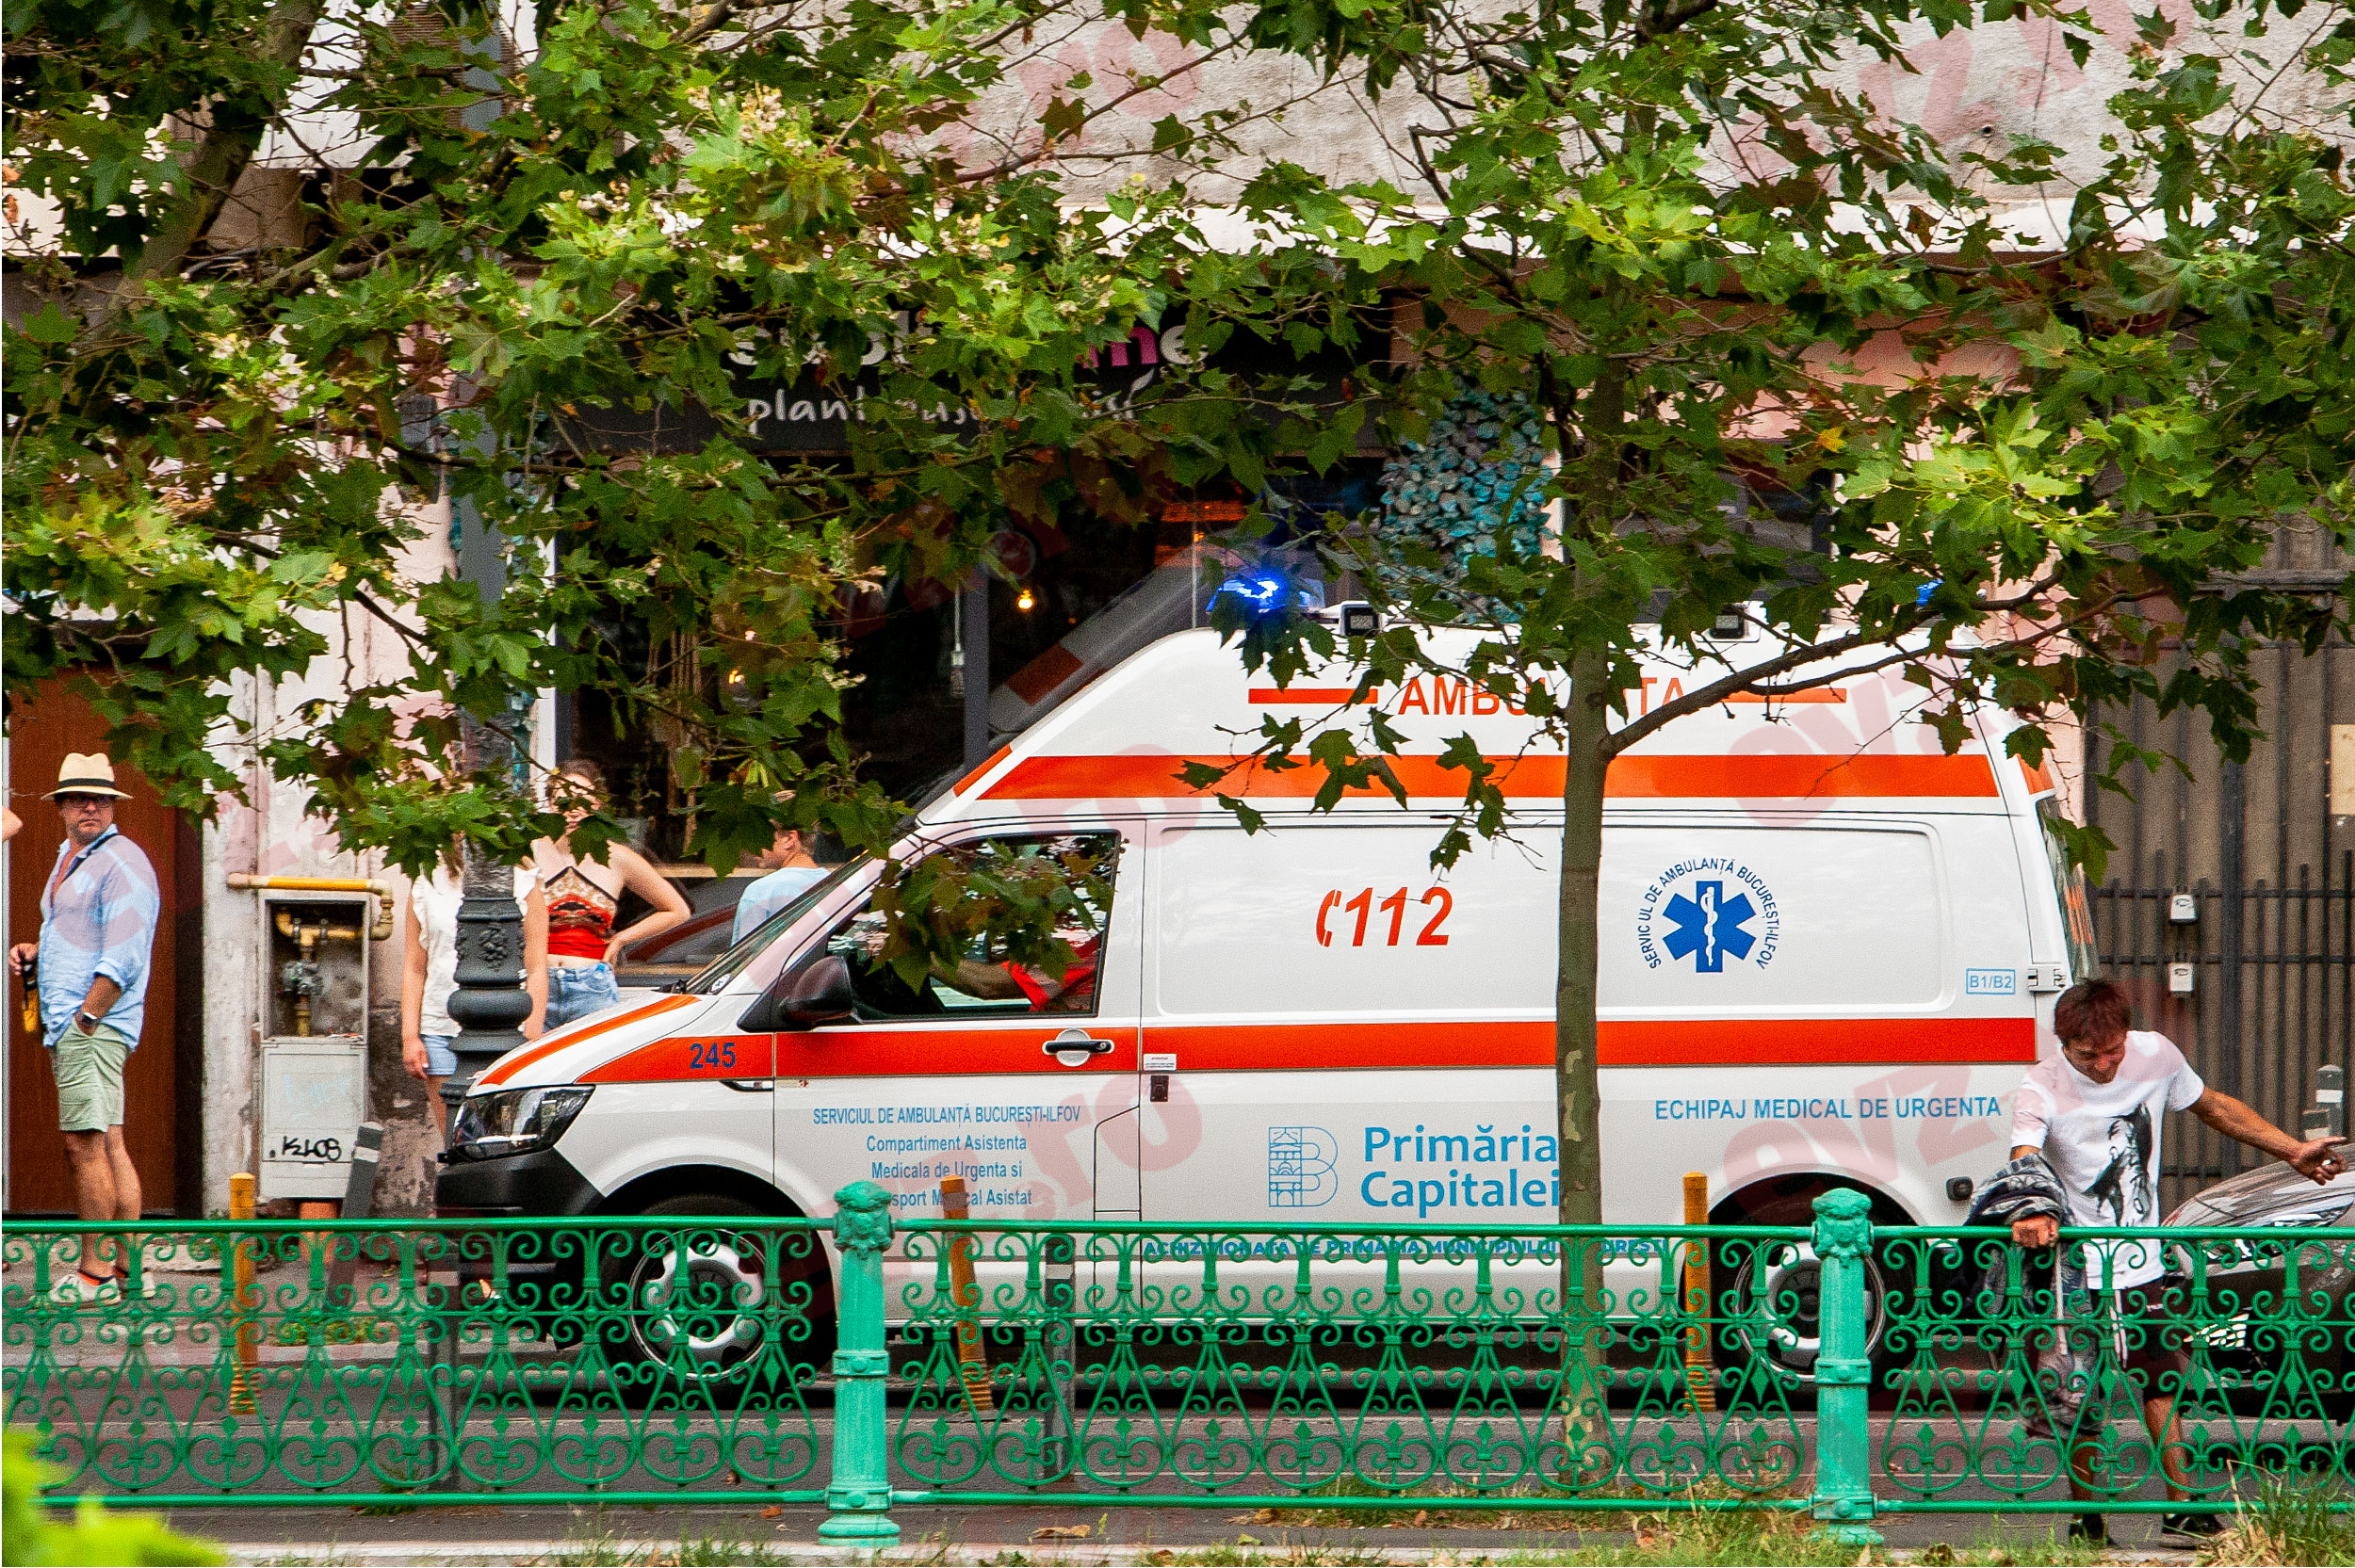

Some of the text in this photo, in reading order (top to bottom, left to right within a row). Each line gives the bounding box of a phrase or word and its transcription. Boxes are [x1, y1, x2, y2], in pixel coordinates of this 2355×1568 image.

[1398, 677, 1685, 716] AMBUTA
[1644, 884, 1663, 904] DE
[1345, 887, 1453, 946] 112
[1970, 975, 2012, 989] B1/B2
[690, 1043, 736, 1069] 245
[813, 1107, 874, 1124] SERVICIUL
[878, 1107, 894, 1124] DE
[1655, 1096, 2002, 1120] ECHIPAJ MEDICAL DE URGENTA
[867, 1134, 1027, 1156] Compartiment Asistenta
[1365, 1124, 1557, 1162] Primăria
[871, 1160, 1022, 1182] Medicala de Urgenta si
[891, 1189, 927, 1210] sport
[986, 1188, 1032, 1206] Asistat
[1361, 1169, 1560, 1219] Capitalei
